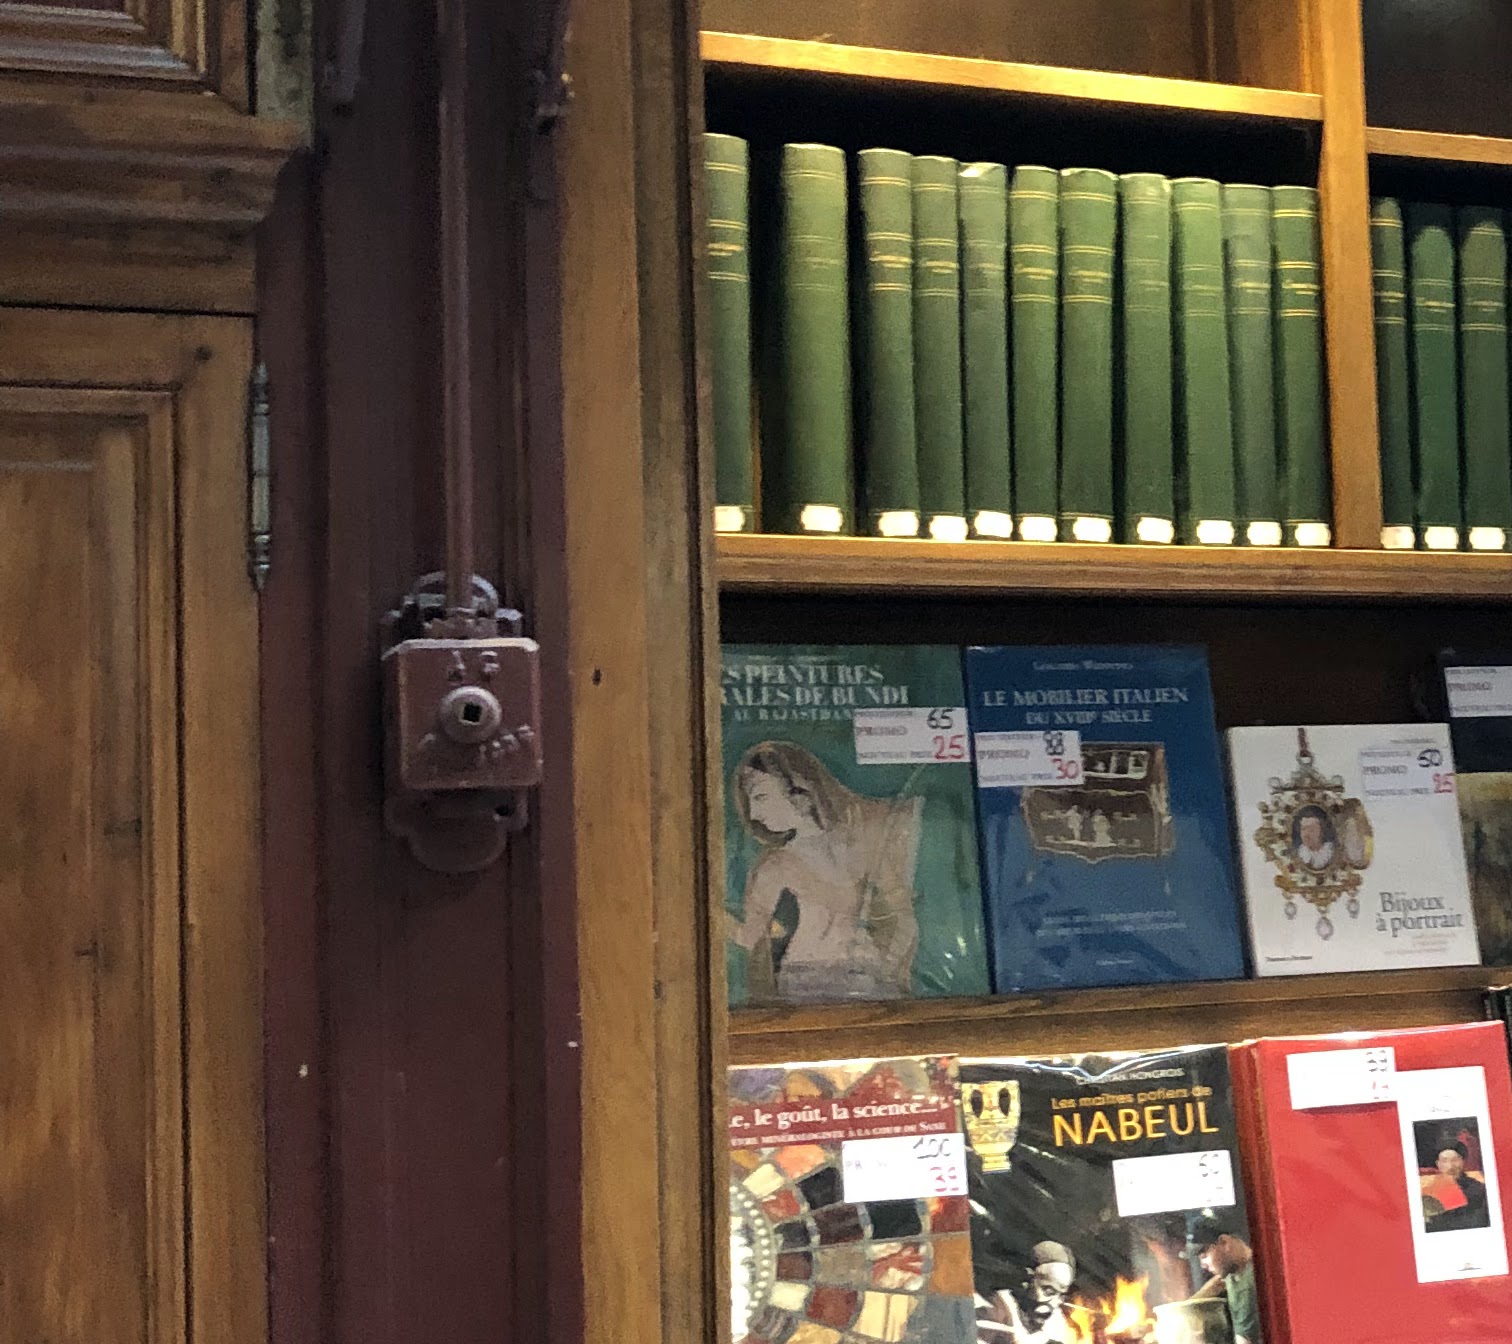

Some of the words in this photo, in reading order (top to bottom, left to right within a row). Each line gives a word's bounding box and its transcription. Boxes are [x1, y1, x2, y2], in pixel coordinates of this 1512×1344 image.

[983, 690, 1008, 707] LE
[1112, 687, 1190, 704] ITALIEN
[932, 735, 965, 760] 25
[1052, 759, 1080, 781] 30
[1379, 892, 1445, 914] Bijoux
[1389, 908, 1465, 938] portrait
[754, 1109, 773, 1126] le
[777, 1105, 828, 1130] goût,
[832, 1103, 850, 1120] la
[1053, 1101, 1219, 1147] NABEUL
